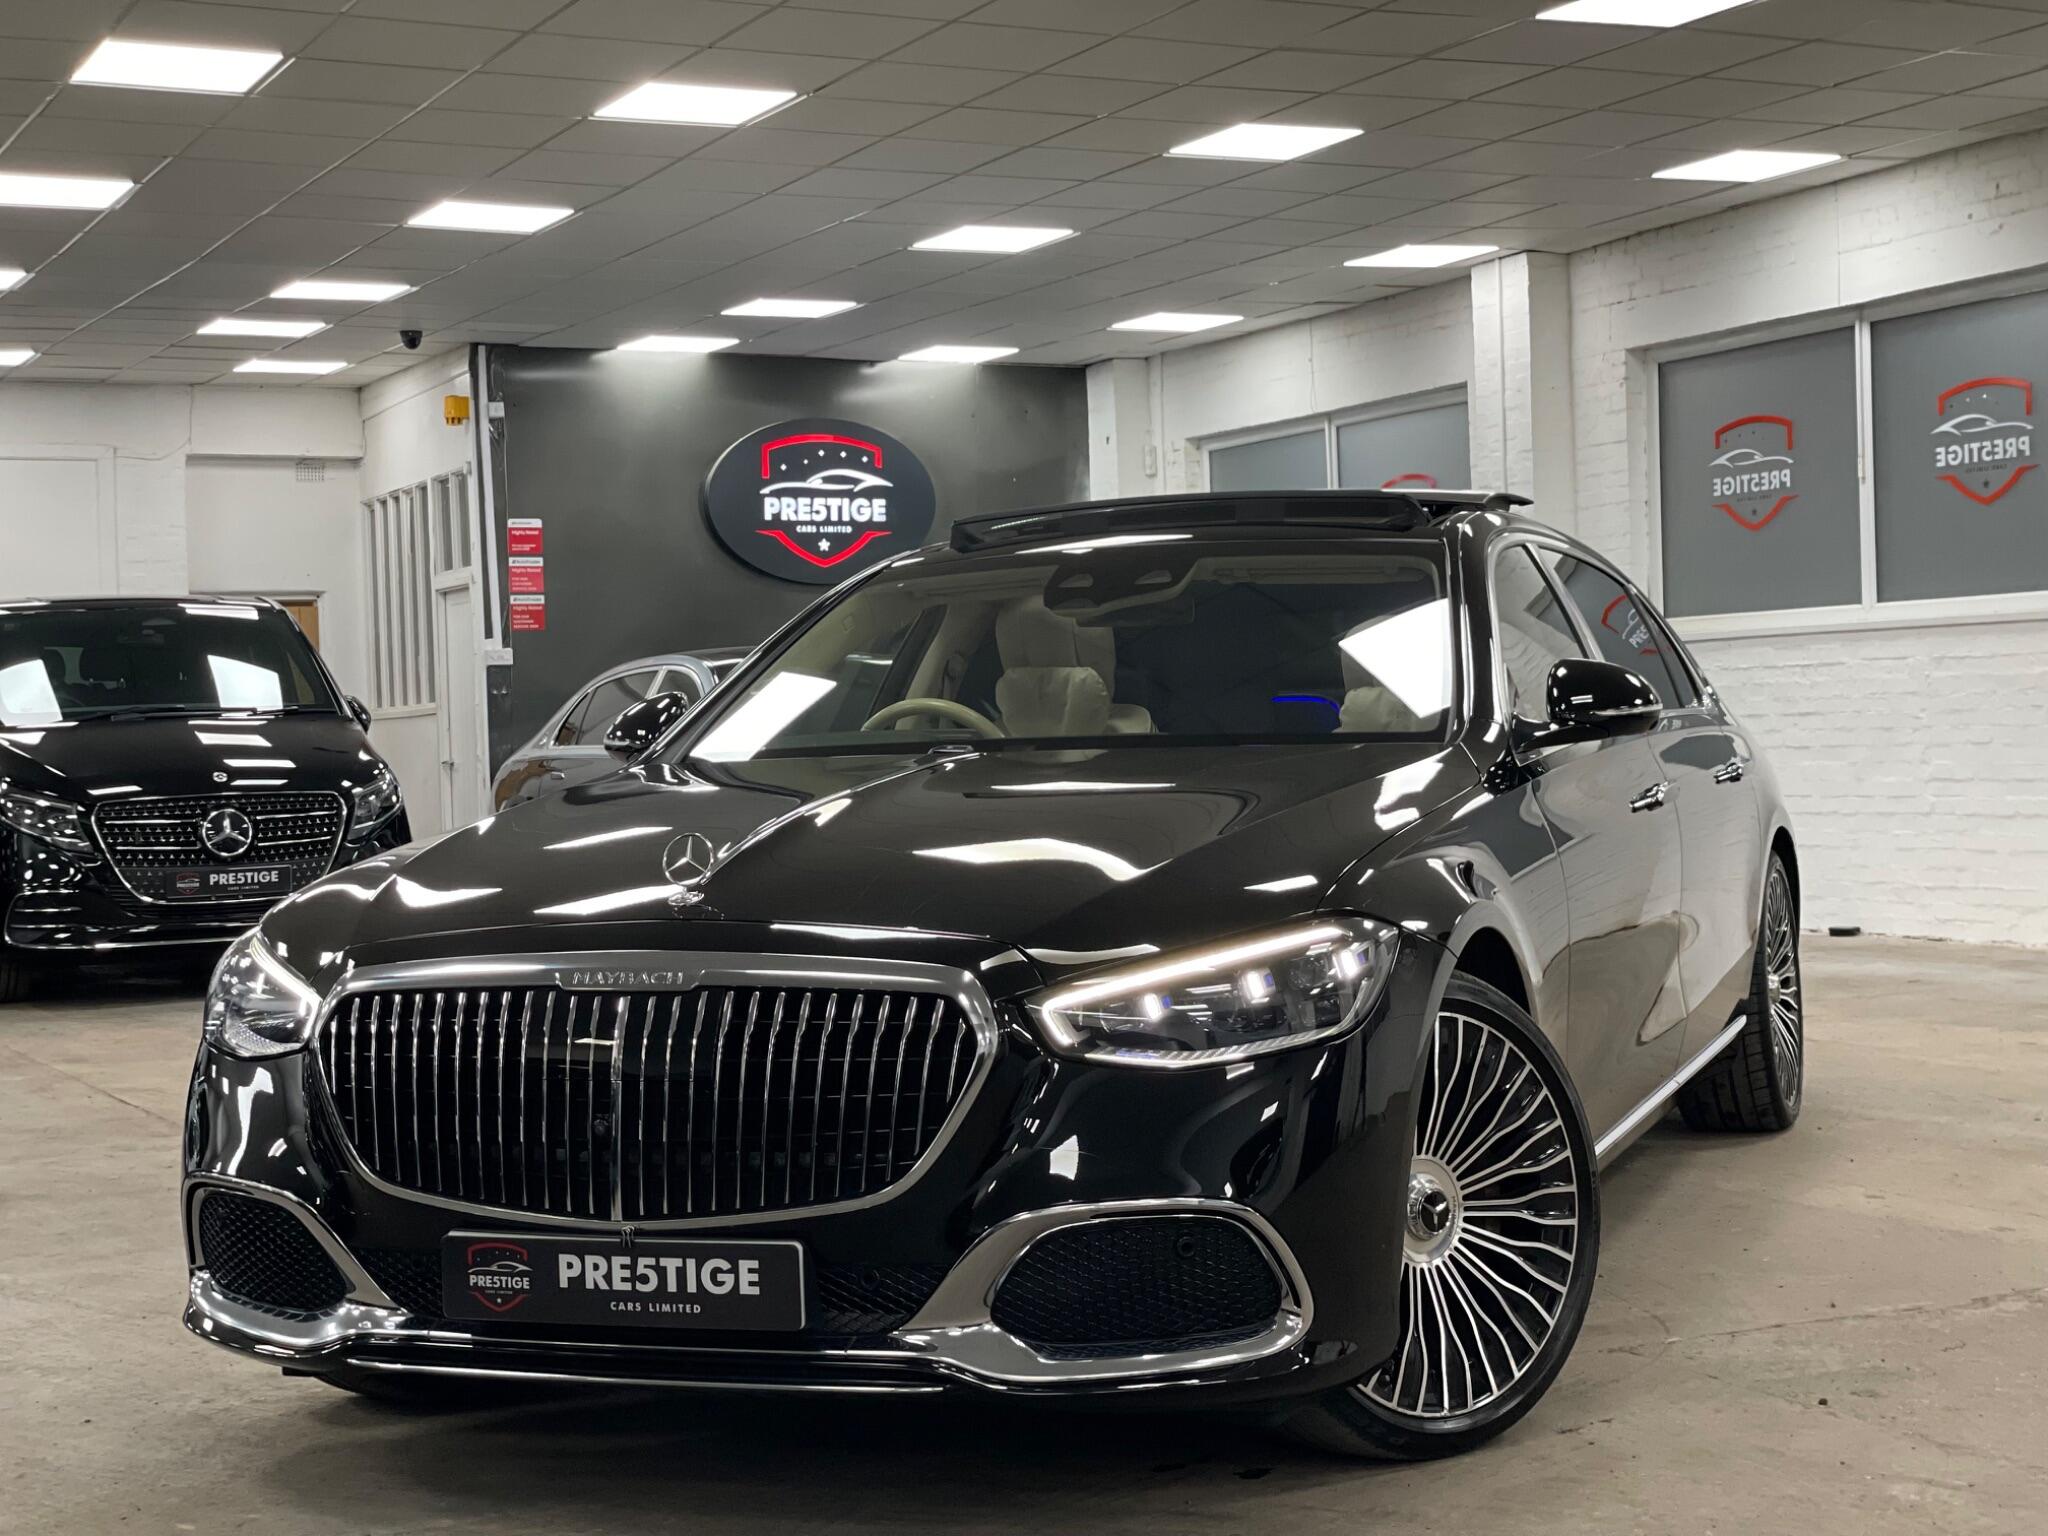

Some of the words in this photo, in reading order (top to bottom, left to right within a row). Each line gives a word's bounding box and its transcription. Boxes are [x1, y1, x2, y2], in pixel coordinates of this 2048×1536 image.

[796, 525, 817, 533] CARS
[819, 525, 852, 533] LIMITED
[572, 971, 684, 985] MAYBACH
[558, 1253, 761, 1296] PRE5TIGE
[610, 1301, 642, 1312] CARS
[648, 1302, 701, 1314] LIMITED
